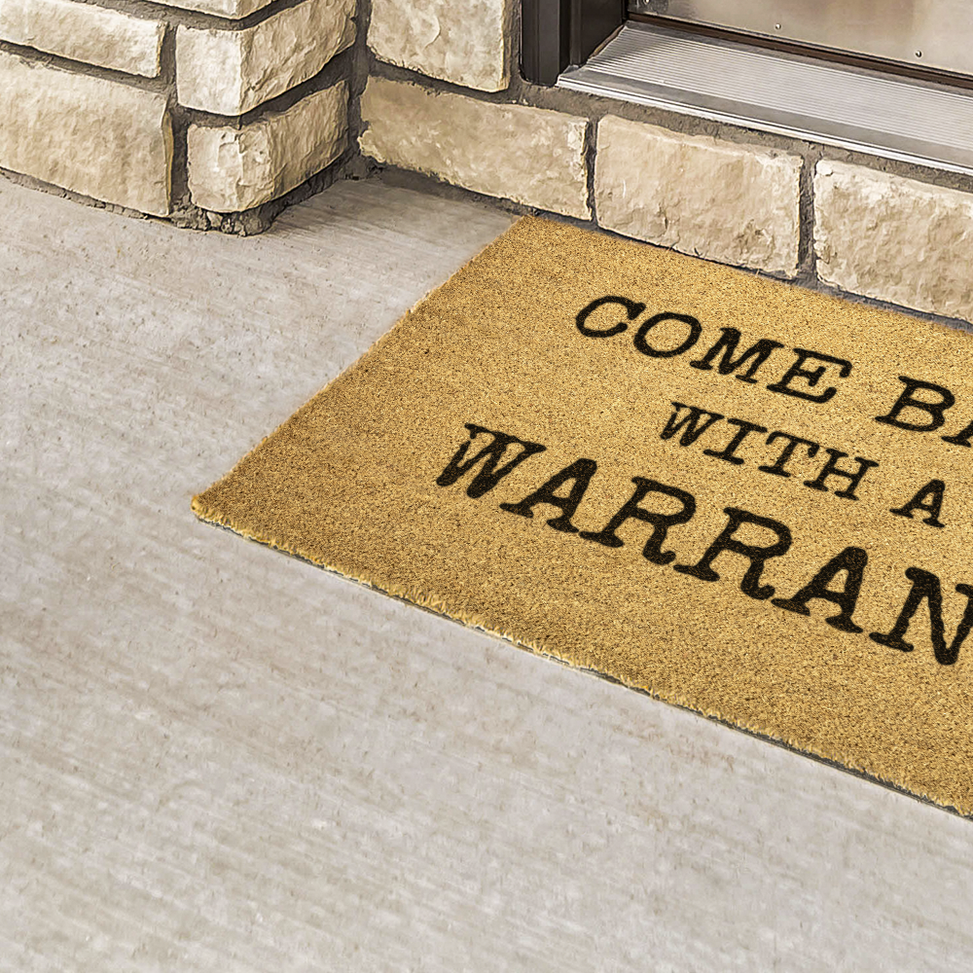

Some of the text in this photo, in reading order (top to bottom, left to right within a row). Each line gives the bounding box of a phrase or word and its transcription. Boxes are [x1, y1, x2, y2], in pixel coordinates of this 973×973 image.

[576, 295, 852, 403] COME
[660, 403, 946, 528] WITH A
